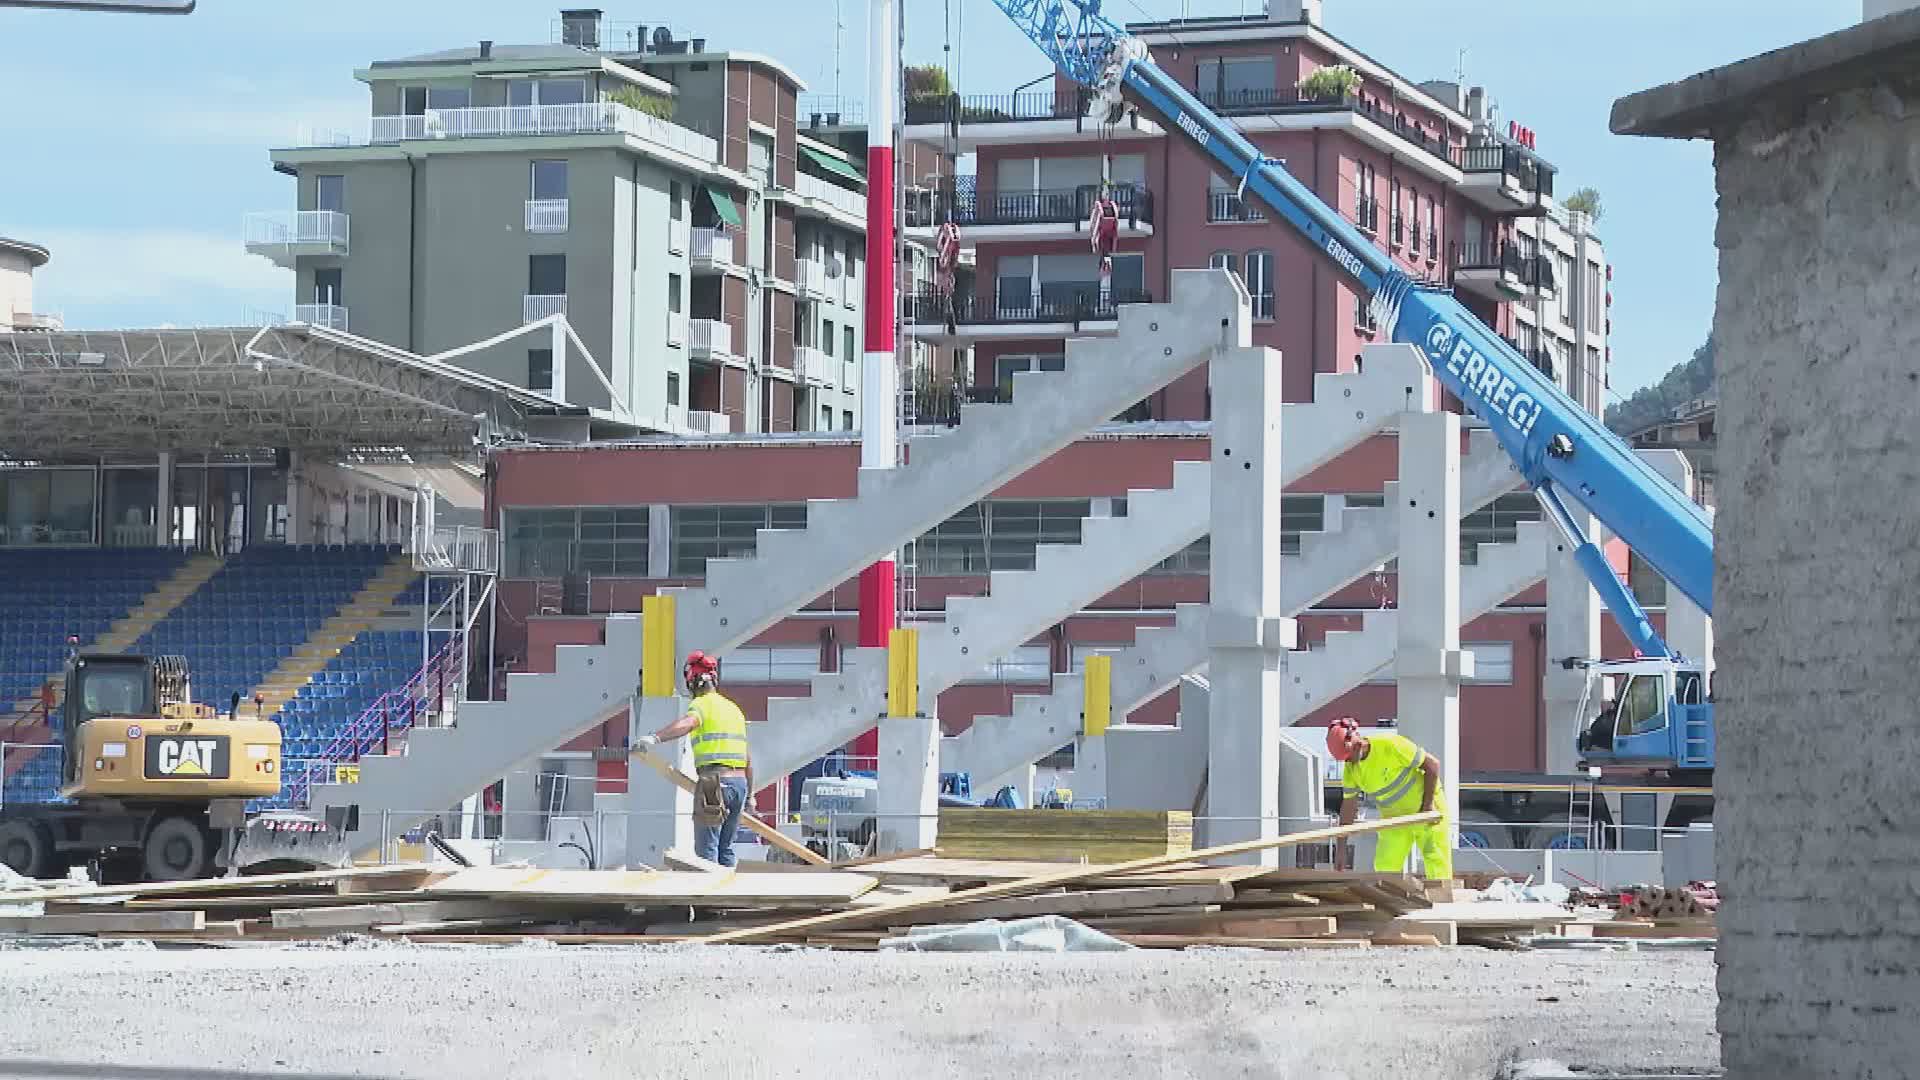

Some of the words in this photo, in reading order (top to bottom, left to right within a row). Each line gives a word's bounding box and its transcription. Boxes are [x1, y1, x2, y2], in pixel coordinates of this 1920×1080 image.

[1176, 110, 1210, 145] ERREGI
[1327, 237, 1364, 278] ERREGI
[1447, 338, 1542, 437] ERREGI
[159, 740, 217, 775] CAT
